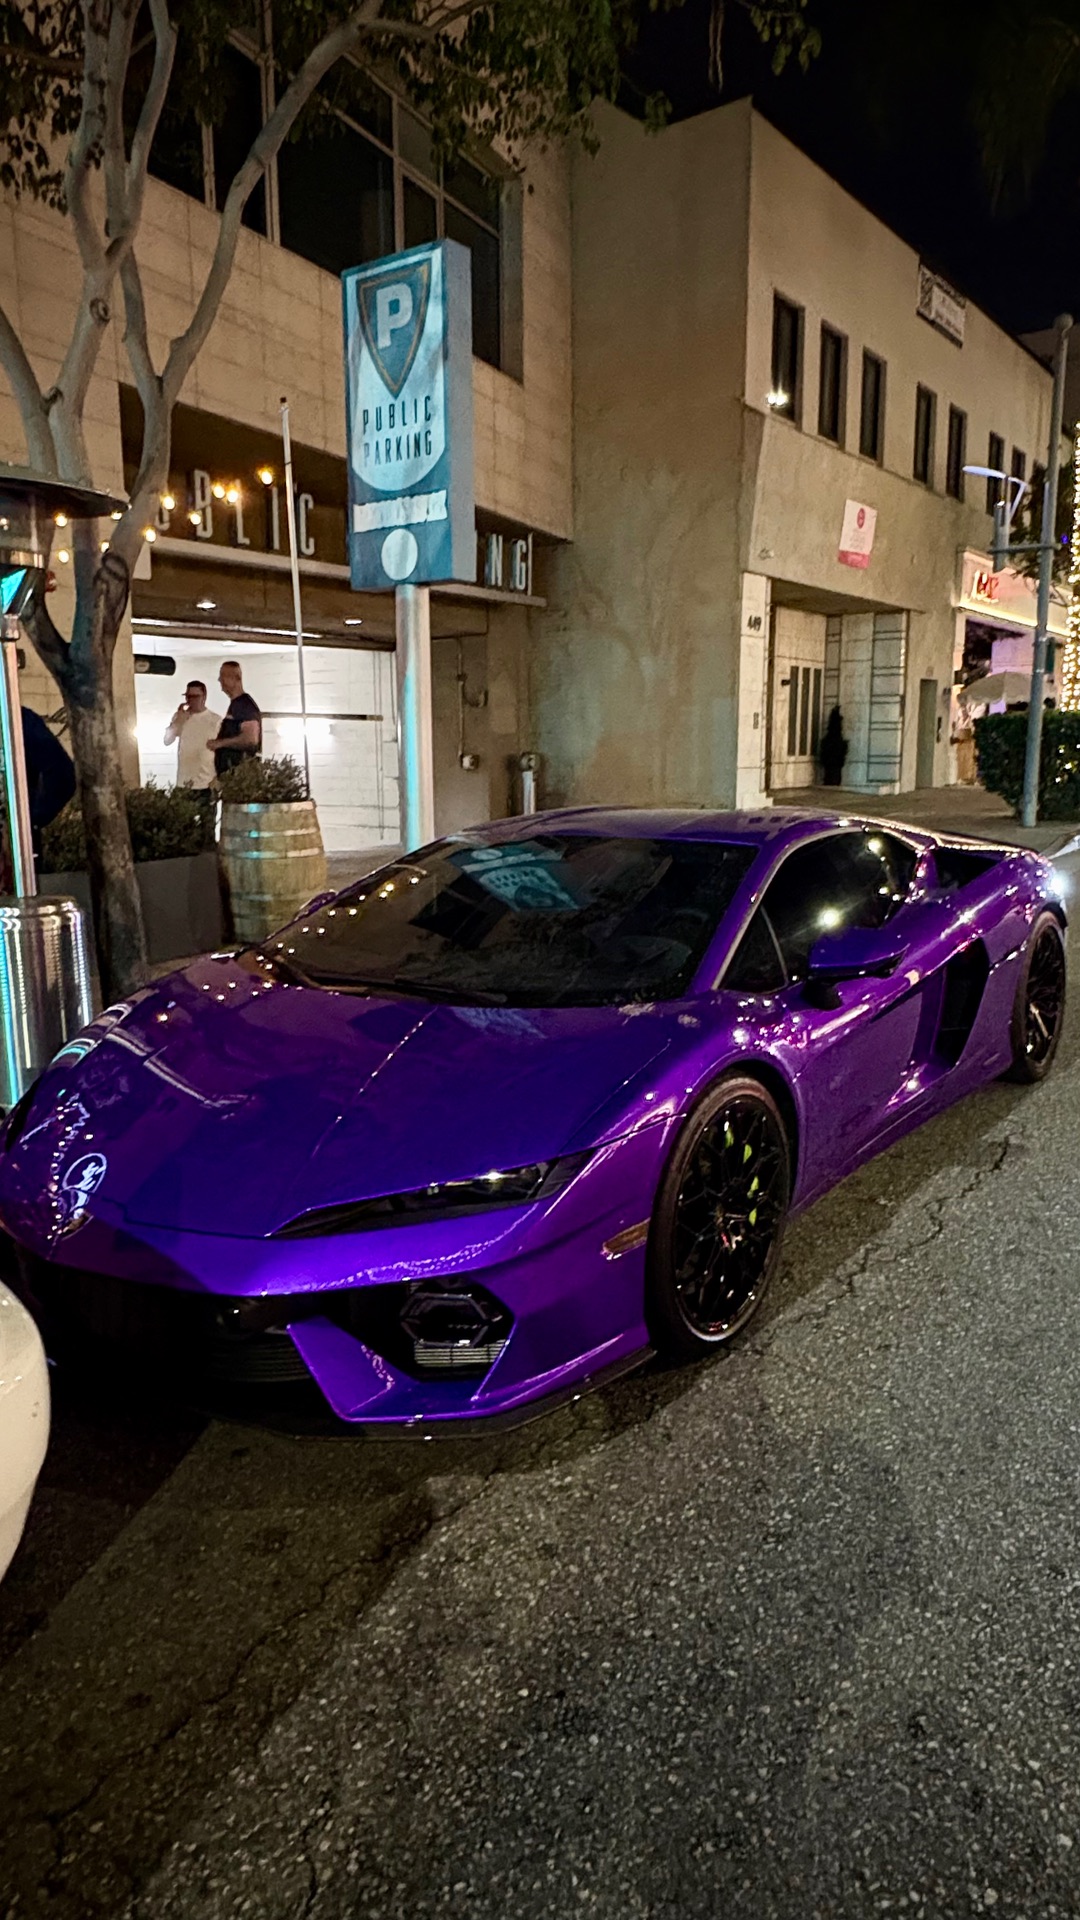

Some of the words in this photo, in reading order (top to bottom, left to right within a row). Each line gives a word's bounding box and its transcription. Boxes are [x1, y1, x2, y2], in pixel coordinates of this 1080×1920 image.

[376, 282, 414, 350] P
[362, 395, 432, 435] PUBLIC
[363, 429, 433, 467] PARKING
